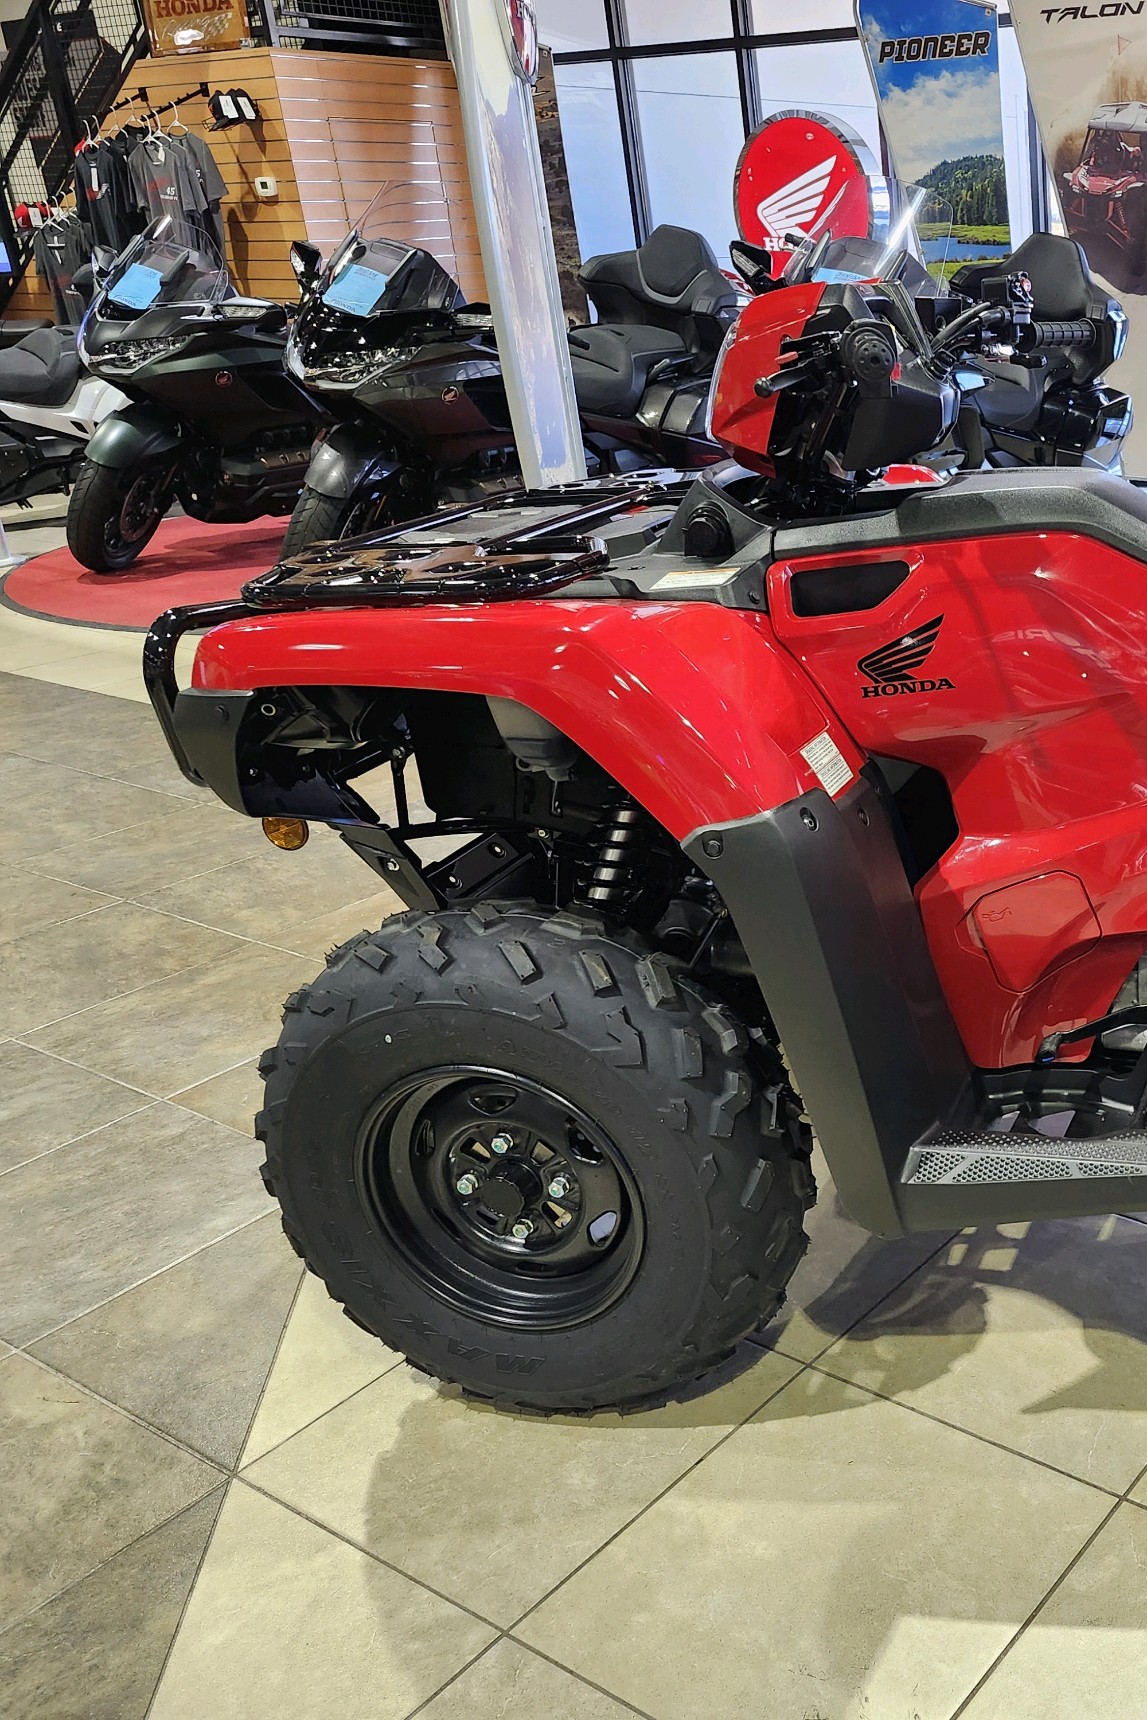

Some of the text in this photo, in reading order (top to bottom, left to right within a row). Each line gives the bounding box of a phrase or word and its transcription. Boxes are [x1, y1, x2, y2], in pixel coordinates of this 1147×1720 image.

[155, 0, 234, 18] HONDA
[1040, 1, 1145, 24] TALON
[878, 30, 990, 64] PIONEER
[861, 678, 957, 699] HONDA
